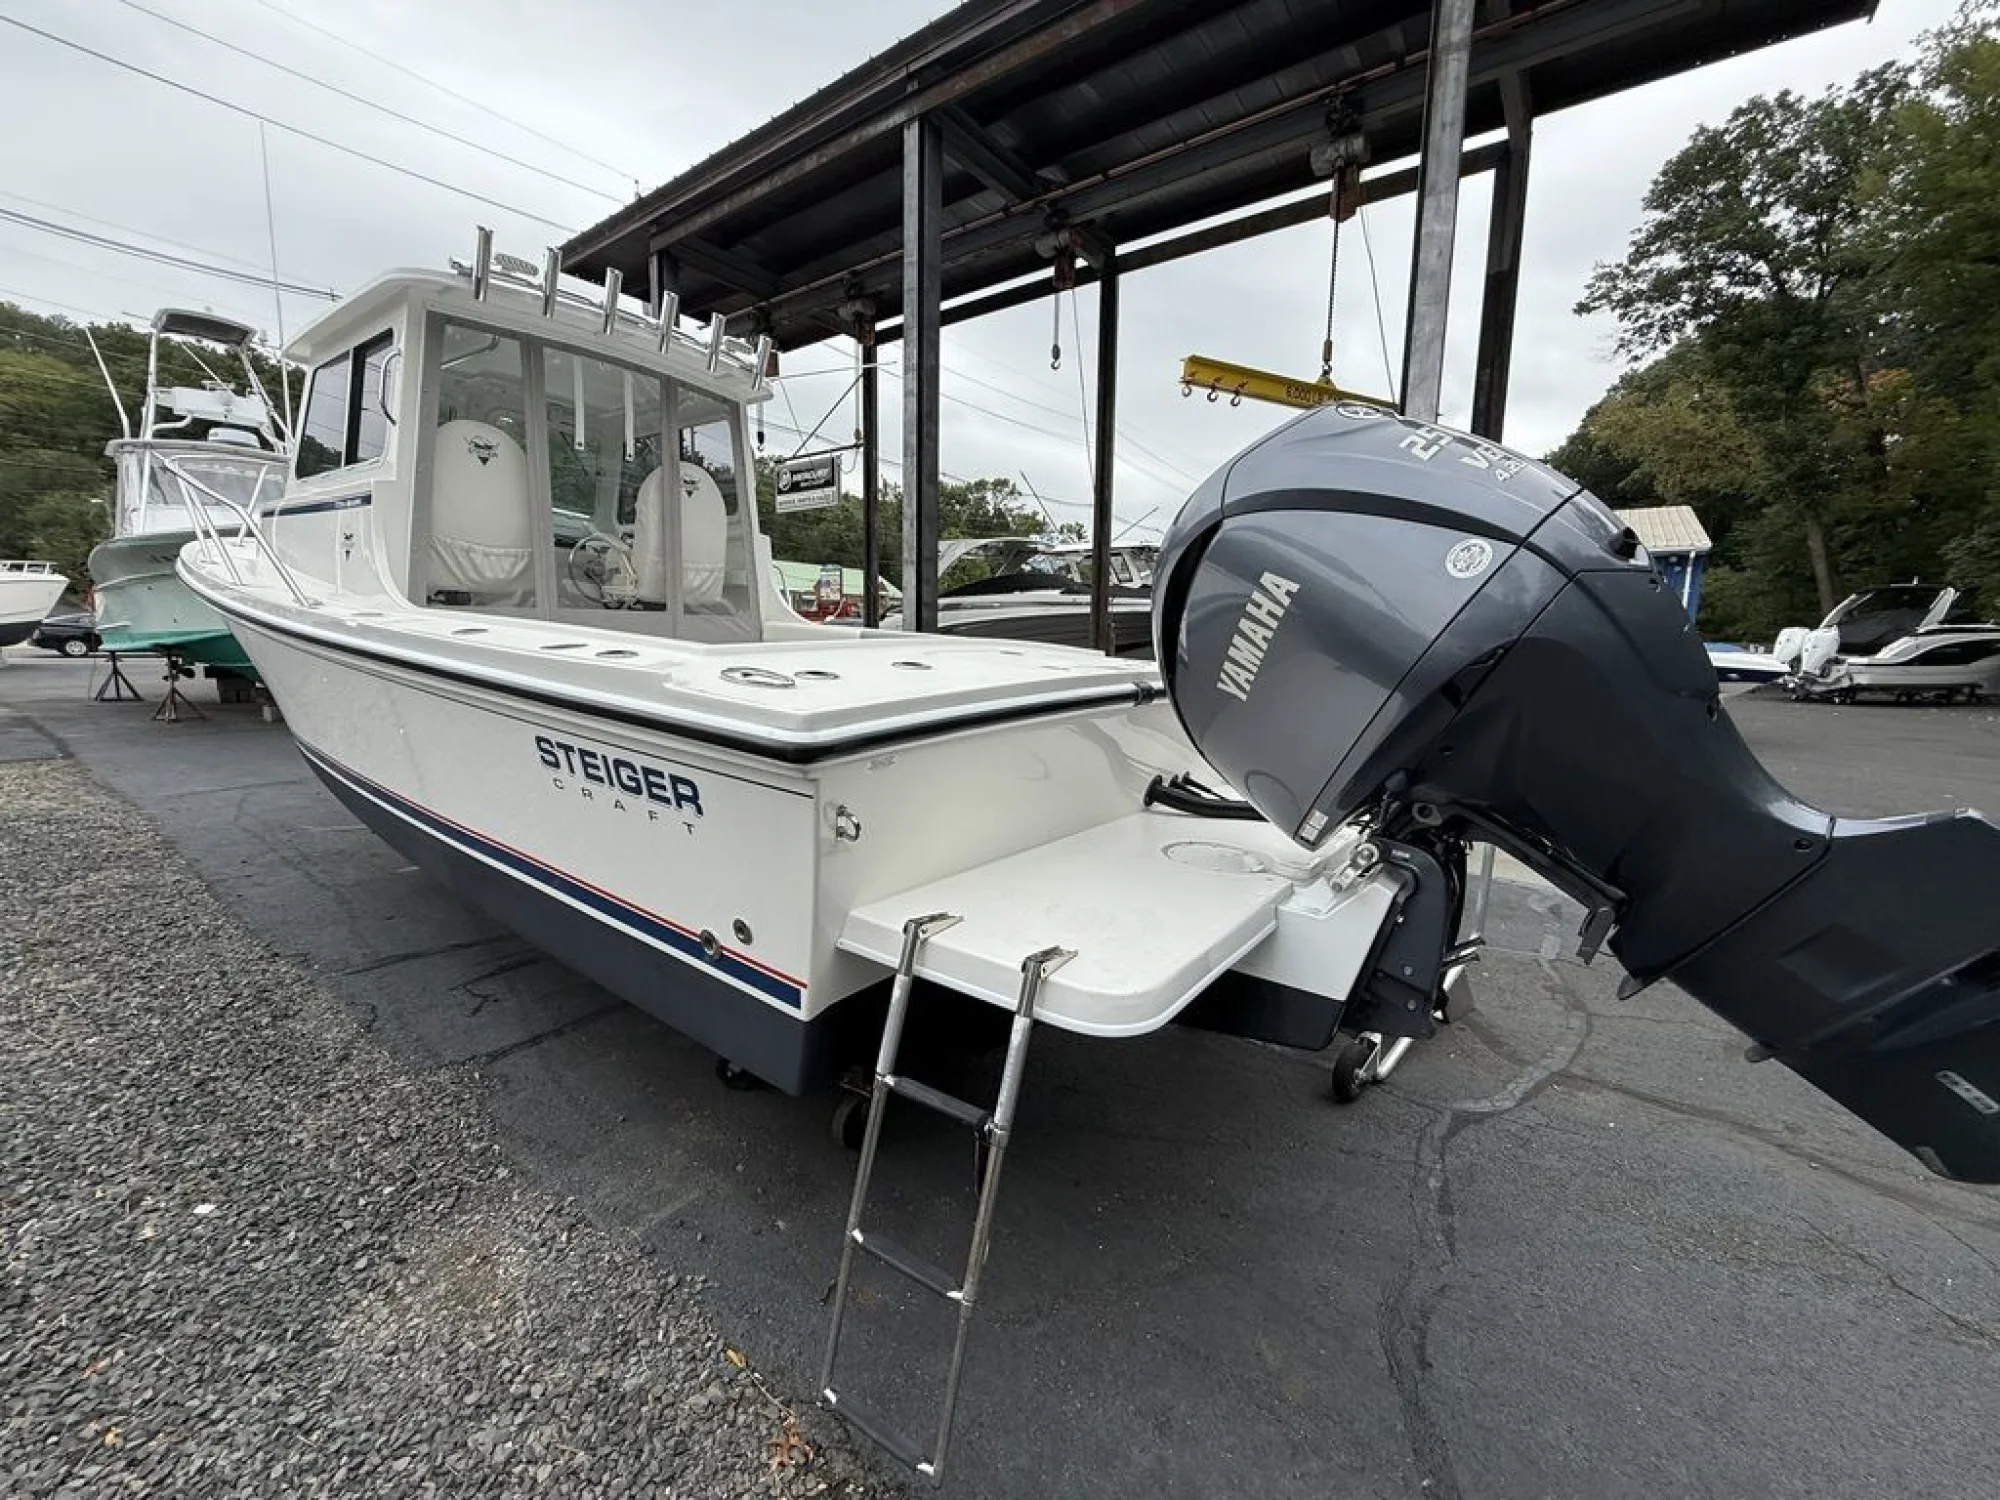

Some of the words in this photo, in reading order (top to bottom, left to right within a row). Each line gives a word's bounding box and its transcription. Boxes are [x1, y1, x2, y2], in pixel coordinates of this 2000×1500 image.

[1216, 571, 1301, 702] YAMAHA
[534, 735, 704, 818] STEIGER
[552, 777, 695, 835] CRAFT
